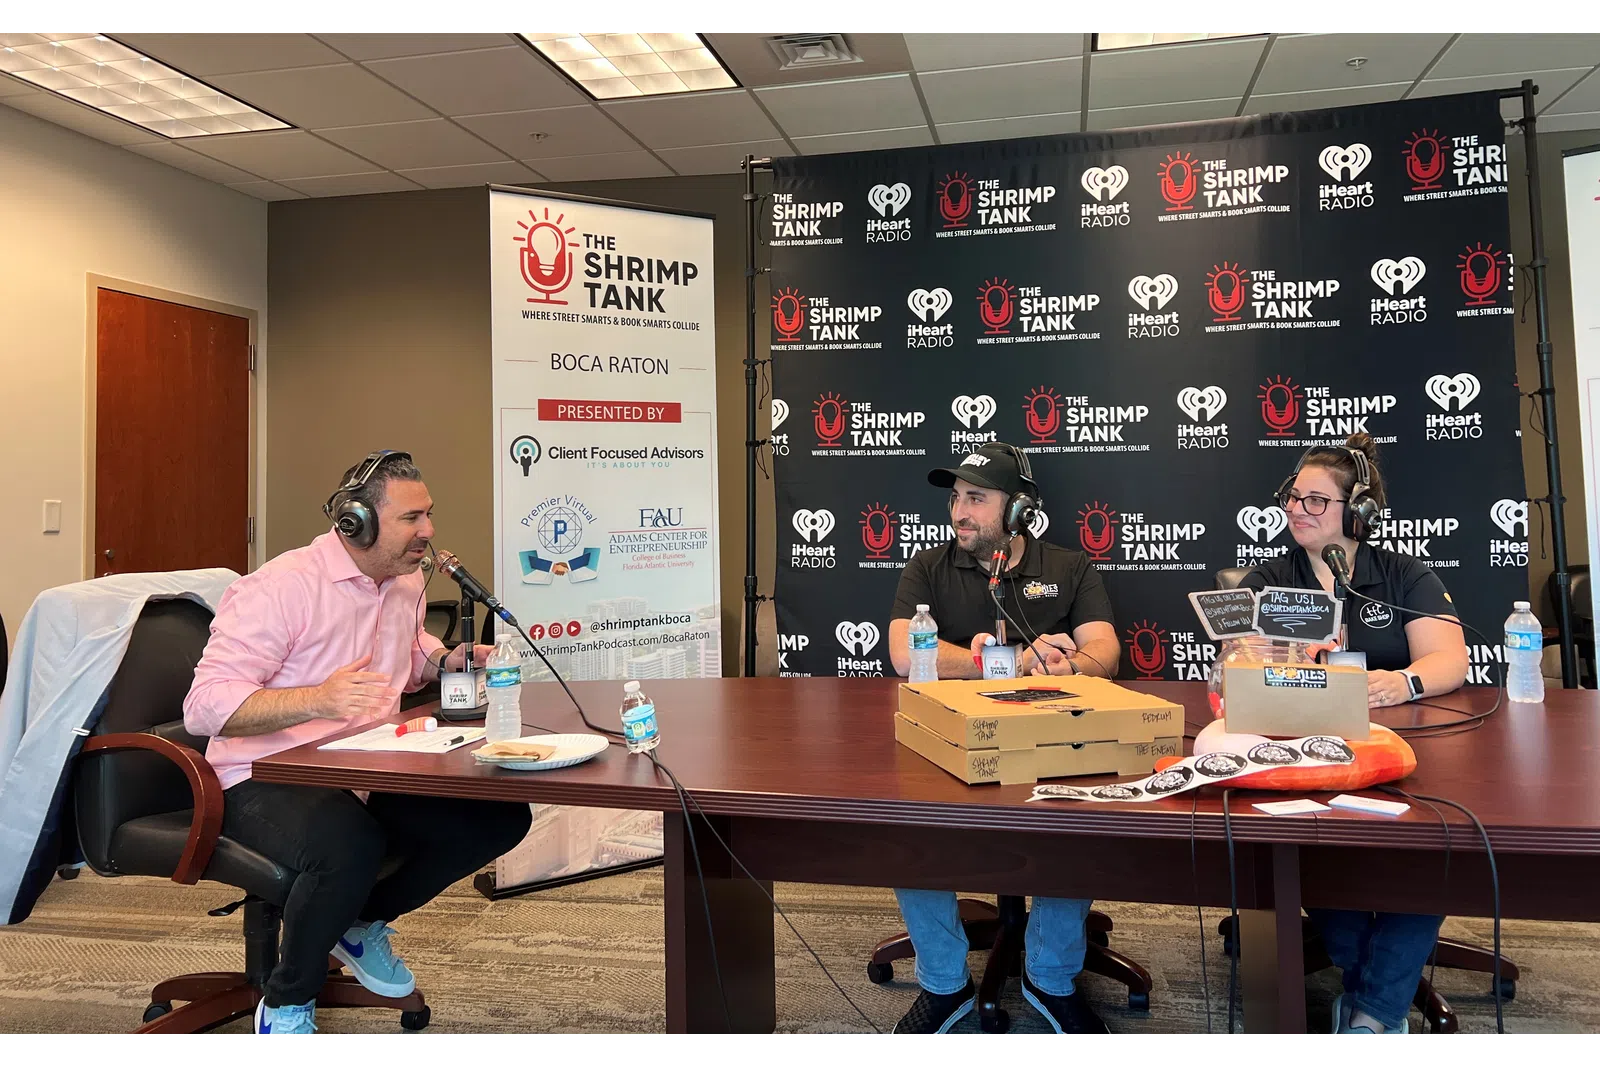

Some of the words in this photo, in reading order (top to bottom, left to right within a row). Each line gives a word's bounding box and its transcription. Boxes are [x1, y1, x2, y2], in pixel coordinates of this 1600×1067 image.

[1452, 135, 1478, 147] THE
[1202, 160, 1226, 171] THE
[1204, 166, 1288, 189] SHRIMP
[978, 180, 999, 190] THE
[1320, 182, 1372, 198] iHeart
[773, 194, 792, 203] THE
[978, 186, 1055, 207] SHRIMP
[1203, 185, 1263, 207] TANK
[1320, 195, 1374, 210] RADIO
[773, 202, 843, 220] SHRIMP
[978, 206, 1031, 225] TANK
[1082, 202, 1129, 216] iHeart
[1158, 214, 1177, 222] WHERE
[1178, 212, 1198, 220] STREET
[1199, 211, 1221, 219] SMARTS
[1244, 207, 1266, 215] SMARTS
[1267, 205, 1291, 214] COLLIDE
[867, 218, 910, 231] iHeart
[1082, 214, 1130, 228] RADIO
[772, 220, 821, 237] TANK
[583, 234, 615, 250] THE
[867, 230, 911, 243] RADIO
[584, 252, 698, 286] SHRIMP
[1251, 271, 1275, 281] THE
[1019, 287, 1041, 297] THE
[1252, 280, 1339, 299] SHRIMP
[584, 282, 666, 313] TANK
[809, 298, 829, 306] THE
[1019, 295, 1100, 314] SHRIMP
[1371, 296, 1426, 312] iHeart
[810, 306, 882, 323] SHRIMP
[1252, 300, 1312, 318] TANK
[522, 310, 550, 320] WHERE
[553, 312, 580, 322] STREET
[582, 315, 611, 324] SMARTS
[613, 317, 619, 325] &
[621, 318, 641, 326] BOOK
[643, 319, 671, 328] SMARTS
[673, 321, 699, 330] COLLIDE
[1020, 314, 1075, 332] TANK
[1129, 312, 1178, 326] iHeart
[1292, 321, 1315, 329] SMARTS
[1316, 320, 1341, 328] COLLIDE
[1371, 310, 1426, 325] RADIO
[810, 324, 859, 340] TANK
[908, 324, 952, 336] iHeart
[1129, 325, 1179, 338] RADIO
[908, 336, 953, 348] RADIO
[552, 353, 603, 372] BOCA
[610, 356, 668, 374] RATON
[1305, 387, 1330, 397] THE
[851, 403, 871, 412] THE
[1066, 396, 1088, 406] THE
[1307, 396, 1396, 416] SHRIMP
[558, 405, 642, 419] PRESENTED
[648, 407, 664, 420] BY
[1067, 406, 1148, 424] SHRIMP
[852, 412, 925, 429] SHRIMP
[1306, 417, 1368, 436] TANK
[1426, 413, 1481, 427] iHeart
[952, 431, 996, 442] iHeart
[1066, 425, 1124, 442] TANK
[1178, 424, 1228, 436] iHeart
[1426, 426, 1482, 440] RADIO
[851, 430, 902, 446] TANK
[1178, 436, 1228, 449] RADIO
[549, 447, 587, 459] Client
[591, 447, 647, 459] Focused
[651, 447, 703, 458] Advisors
[521, 497, 560, 527] Premier
[565, 495, 597, 524] Virtual
[639, 508, 683, 528] FAU
[899, 514, 920, 523] THE
[1120, 514, 1144, 523] THE
[609, 534, 647, 543] ADAMS
[649, 532, 687, 542] CENTER
[690, 531, 707, 539] FOR
[1122, 524, 1205, 541] SHRIMP
[610, 541, 707, 554] ENTREPRENEURSHIP
[792, 544, 835, 556] iHeart
[1122, 543, 1180, 560] TANK
[792, 557, 835, 568] RADIO
[1270, 592, 1288, 604] TAG
[1295, 594, 1314, 604] US!
[1261, 603, 1329, 614] @SHRIMPTANKBOCA
[590, 614, 690, 632] @shrimptankboca
[1170, 632, 1194, 642] THE
[837, 657, 882, 670] iHeart
[972, 719, 998, 730] SHRIMP
[974, 730, 996, 742] TANK
[1135, 744, 1149, 756] THE
[1151, 743, 1176, 756] ENEMY
[972, 756, 1000, 770] SHRIMP
[976, 768, 999, 778] TANK
